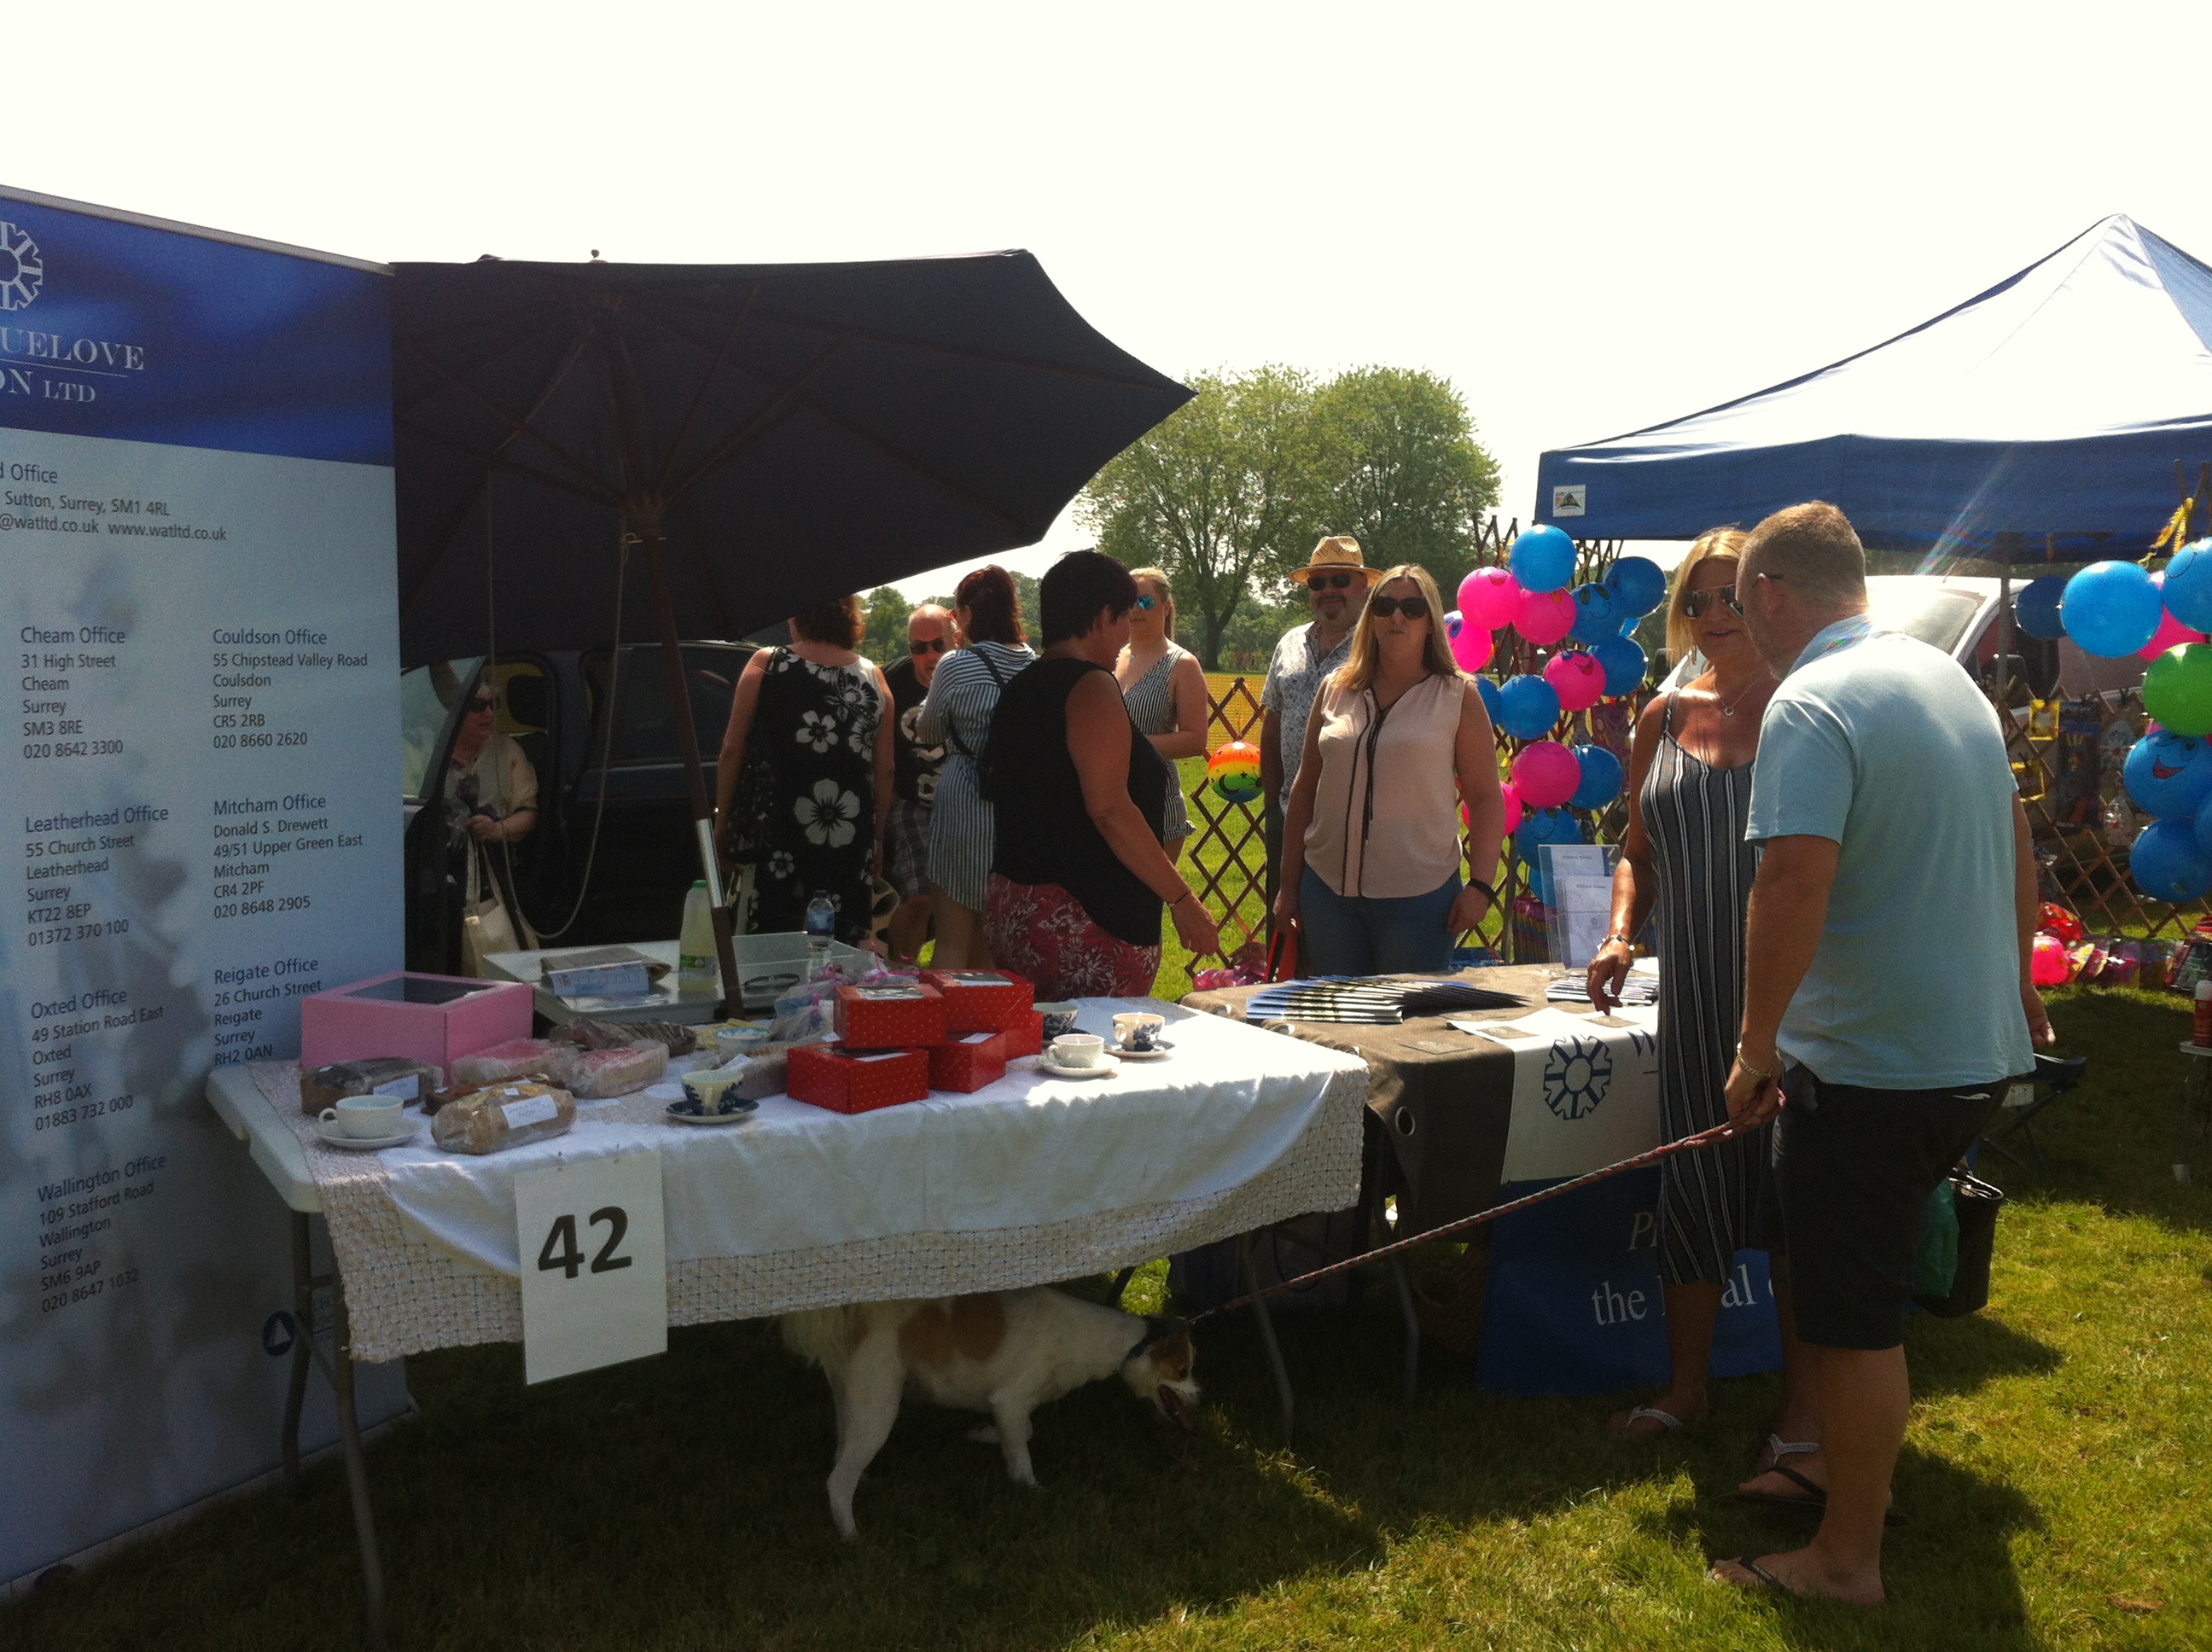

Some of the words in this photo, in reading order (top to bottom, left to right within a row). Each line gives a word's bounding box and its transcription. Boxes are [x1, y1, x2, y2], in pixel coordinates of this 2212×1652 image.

[44, 380, 96, 403] LTD
[11, 463, 58, 484] Office
[5, 491, 55, 511] Sutton,
[60, 495, 106, 515] Surrey,
[112, 498, 140, 515] SM1
[146, 501, 171, 516] 4RL
[108, 521, 227, 541] www.watltd.co.uk
[21, 626, 74, 644] Cheam
[79, 626, 125, 643] Office
[213, 629, 280, 644] Couldson
[285, 628, 327, 644] Office
[21, 654, 38, 667] 31
[44, 654, 74, 671] High
[78, 654, 116, 668] Street
[213, 654, 228, 666] 55
[231, 654, 294, 669] Chipstead
[298, 654, 333, 669] Valley
[338, 654, 368, 666] Road
[22, 677, 69, 691] Cheam
[213, 673, 271, 687] Coulsdon
[23, 700, 66, 716] Surrey
[213, 695, 252, 710] Surrey
[23, 722, 54, 736] SM3
[59, 720, 82, 735] 8RE
[213, 715, 236, 728] CR5
[241, 714, 265, 727] 2RB
[24, 744, 50, 759] 020
[55, 742, 87, 757] 8642
[92, 740, 124, 754] 3300
[213, 736, 236, 748] 020
[241, 734, 272, 747] 8660
[277, 732, 307, 746] 2620
[214, 800, 277, 816] Mitcham
[282, 794, 326, 811] Office
[26, 808, 119, 833] Leatherhead
[124, 805, 169, 822] Office
[214, 821, 258, 838] Donald
[278, 817, 329, 833] Drewett
[26, 843, 44, 857] 55
[49, 838, 95, 855] Church
[100, 834, 135, 850] Street
[213, 842, 247, 858] 49/51
[253, 841, 292, 858] Upper
[296, 836, 334, 850] Green
[338, 833, 363, 847] East
[26, 858, 109, 880] Leatherhead
[214, 861, 270, 878] Mitcham
[27, 886, 71, 904] Surrey
[214, 884, 237, 899] CR4
[242, 881, 264, 895] 2PF
[27, 909, 62, 924] KT22
[67, 904, 90, 919] 8EP
[214, 904, 237, 919] 020
[242, 899, 274, 915] 8648
[279, 895, 310, 910] 2905
[29, 928, 72, 946] 01372
[76, 923, 102, 940] 370
[106, 919, 129, 934] 100
[215, 964, 270, 986] Reigate
[274, 957, 318, 976] Office
[31, 998, 76, 1020] Oxted
[81, 987, 127, 1009] Office
[215, 993, 230, 1007] 26
[234, 985, 280, 1004] Church
[284, 980, 322, 995] Street
[32, 1028, 49, 1043] 49
[53, 1019, 100, 1040] Station
[104, 1012, 136, 1028] Road
[140, 1006, 165, 1022] East
[215, 1008, 262, 1027] Reigate
[215, 1030, 255, 1047] Surrey
[32, 1044, 72, 1065] Oxted
[215, 1051, 240, 1066] RH2
[244, 1044, 273, 1062] 0AN
[34, 1068, 75, 1088] Surrey
[35, 1092, 61, 1109] RH8
[66, 1084, 92, 1100] 0AX
[35, 1110, 78, 1131] 01883
[82, 1102, 105, 1120] 732
[110, 1096, 133, 1112] 000
[38, 1169, 120, 1203] Wallington
[125, 1155, 166, 1178] Office
[39, 1209, 64, 1225] 109
[68, 1190, 119, 1217] Stafford
[124, 1180, 154, 1201] Road
[39, 1218, 111, 1248] Wallington
[538, 1206, 632, 1279] 42
[41, 1248, 82, 1270] Surrey
[42, 1272, 71, 1292] SM6
[76, 1260, 101, 1279] 9AP
[42, 1294, 68, 1312] 020
[72, 1280, 104, 1303] 8647
[1591, 1281, 1648, 1325] the
